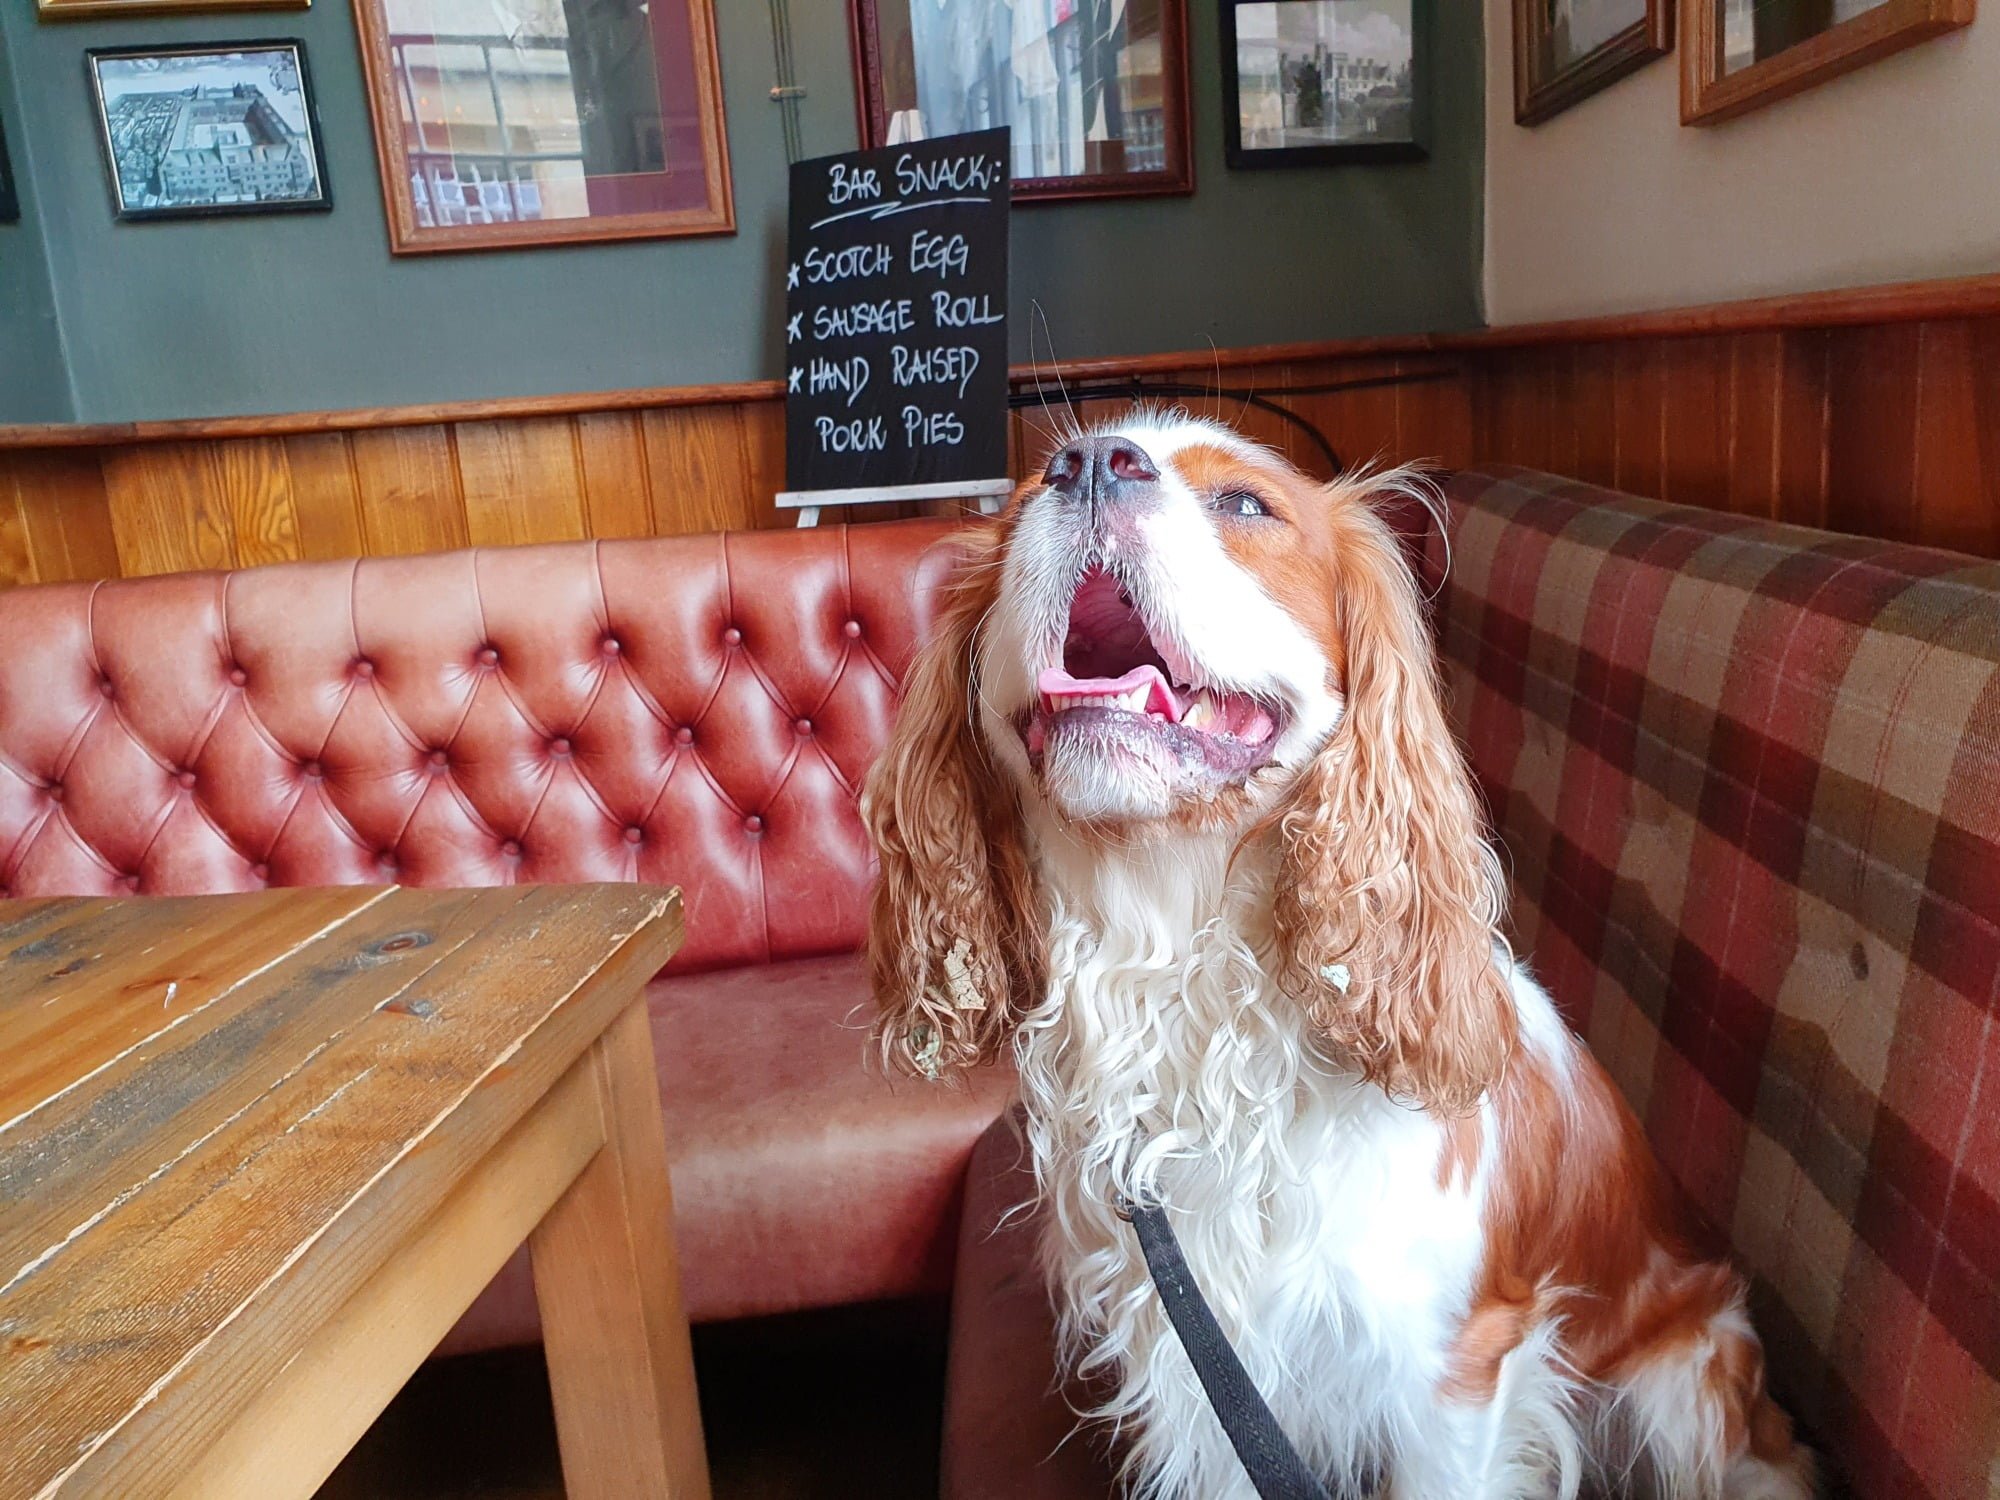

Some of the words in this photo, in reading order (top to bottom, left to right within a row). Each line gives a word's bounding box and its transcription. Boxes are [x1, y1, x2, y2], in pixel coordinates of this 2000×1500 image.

[829, 163, 880, 203] BAR
[895, 154, 1001, 196] SNACK:
[804, 246, 893, 284] SCOTCH
[910, 230, 969, 279] EGG
[813, 300, 915, 341] SAUSAGE
[931, 291, 1004, 328] ROLL
[810, 356, 870, 407] HAND
[890, 346, 979, 399] RAISED
[815, 415, 887, 453] PORK
[902, 405, 964, 448] PIES
